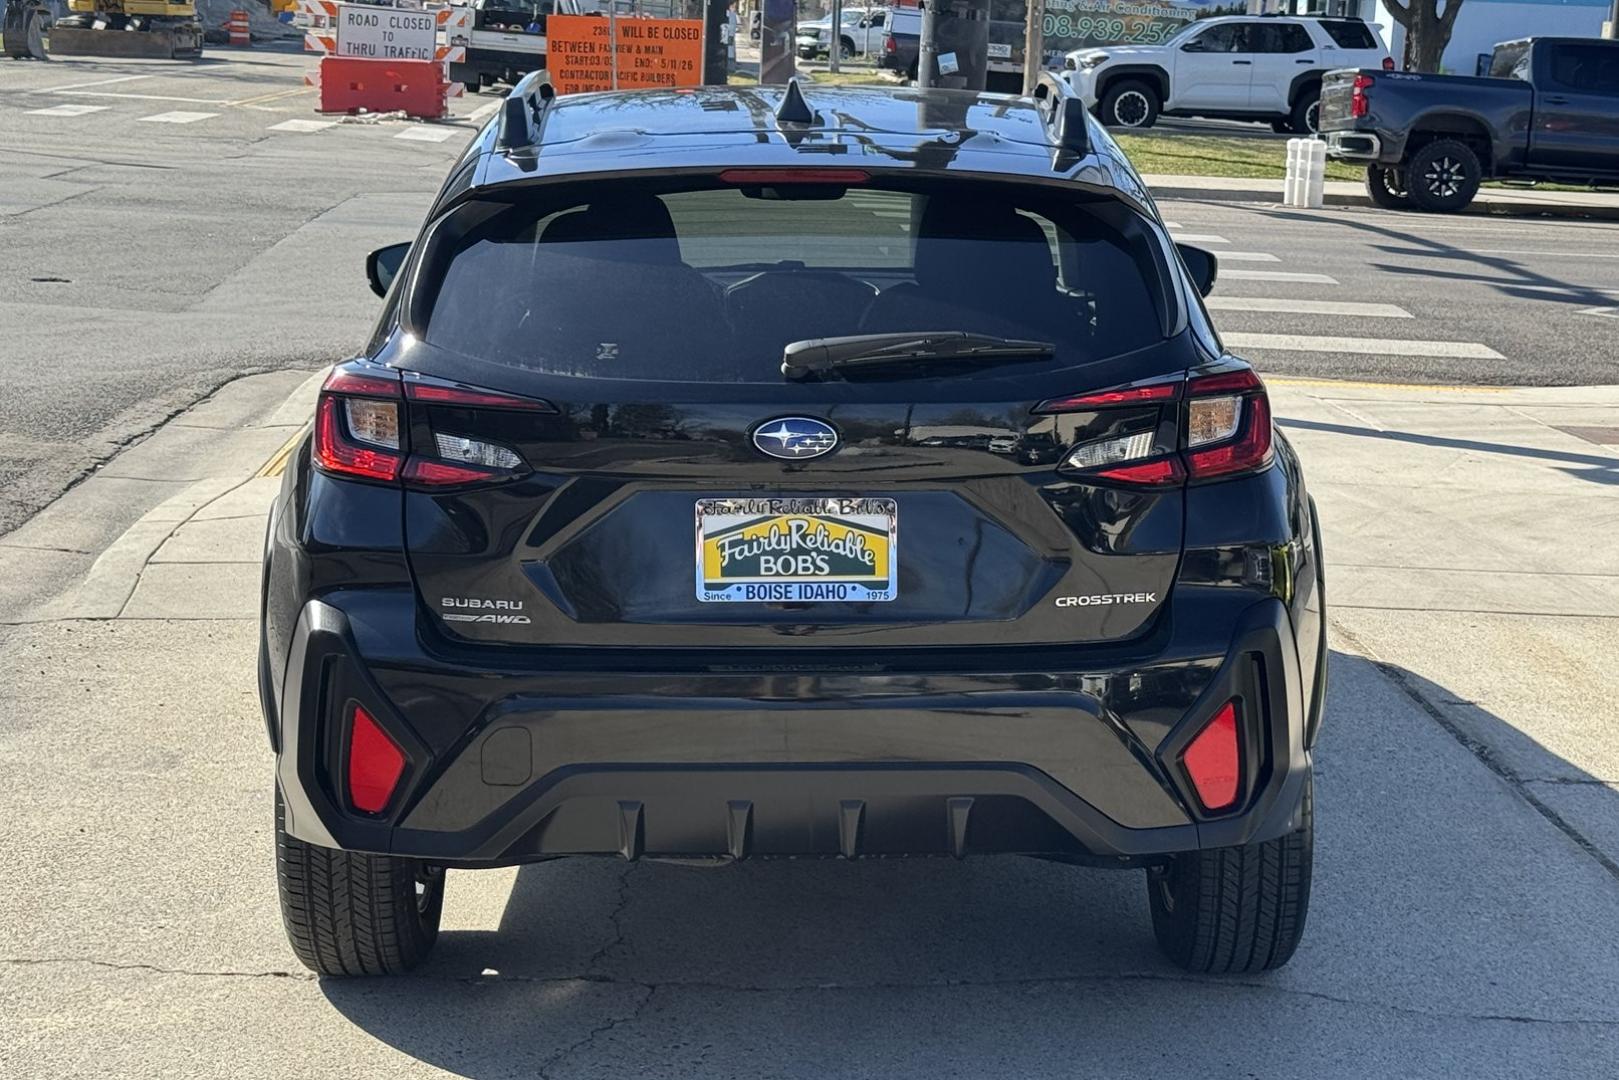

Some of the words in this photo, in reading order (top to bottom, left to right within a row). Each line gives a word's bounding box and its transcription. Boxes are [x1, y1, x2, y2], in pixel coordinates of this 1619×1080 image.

[1114, 1, 1197, 21] Conditioning
[348, 13, 379, 27] ROAD
[389, 16, 432, 31] CLOSED
[1043, 14, 1179, 44] 08.939.256
[382, 31, 394, 42] TO
[622, 25, 645, 38] WILL
[647, 26, 659, 39] BE
[663, 27, 699, 40] CLOSED
[346, 42, 376, 56] THRU
[384, 45, 429, 60] TRAFFIC
[551, 40, 596, 53] BETWEEN
[644, 46, 664, 55] MAIN
[661, 58, 693, 71] 5/11/26
[611, 71, 638, 82] ACIFIC
[640, 72, 676, 86] BUILDERS
[718, 524, 790, 566] Fairly
[787, 518, 875, 566] Reliable
[759, 551, 830, 576] BOB'S
[704, 592, 732, 601] Since
[745, 584, 793, 600] BOISE
[798, 584, 848, 600] IDAHO
[866, 591, 890, 600] 1975
[1055, 592, 1156, 607] CROSSTREK
[441, 597, 523, 610] SUBARU
[475, 614, 532, 624] AWD
